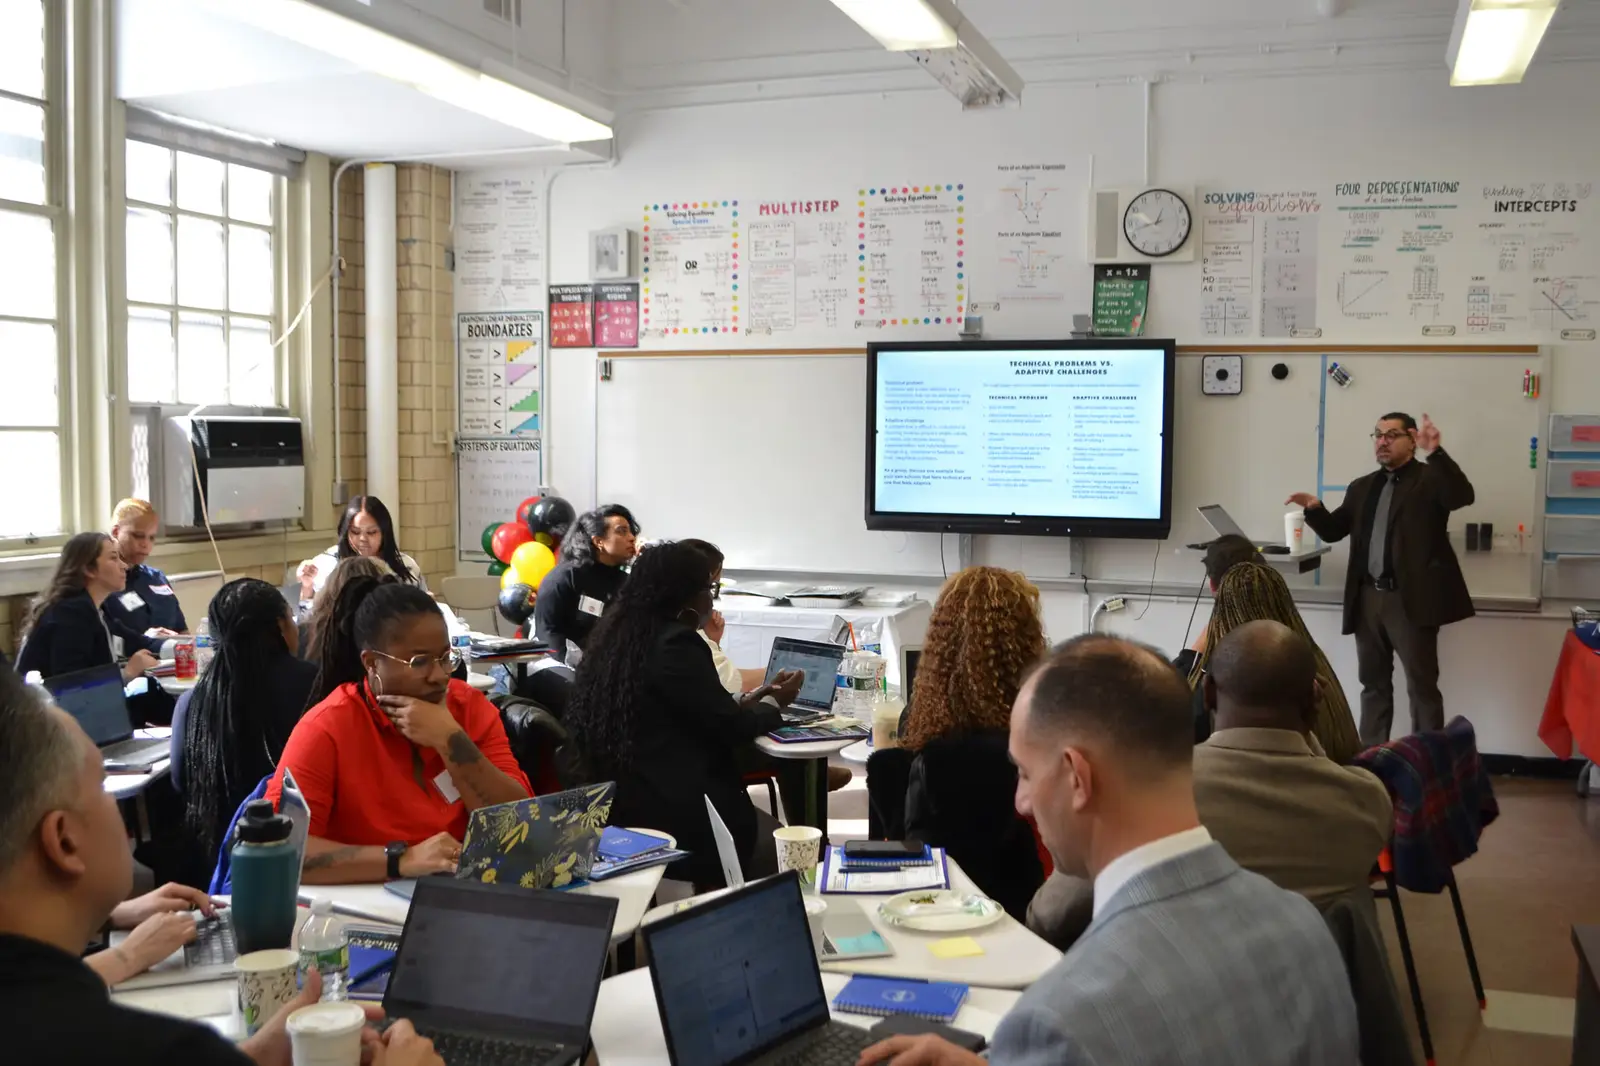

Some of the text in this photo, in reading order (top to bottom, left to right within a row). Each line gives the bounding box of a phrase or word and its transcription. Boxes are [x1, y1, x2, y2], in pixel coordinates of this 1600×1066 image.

[1335, 180, 1460, 196] FOUR REPRESENTATIONS
[1204, 192, 1255, 204] SOLVING
[759, 200, 840, 216] MULTISTEP
[1218, 197, 1322, 219] equations
[1494, 200, 1578, 212] INTERCEPTS
[685, 260, 698, 270] OR
[467, 323, 533, 338] BOUNDARIES
[459, 442, 540, 451] SYSTEMS OF EQUATIONS
